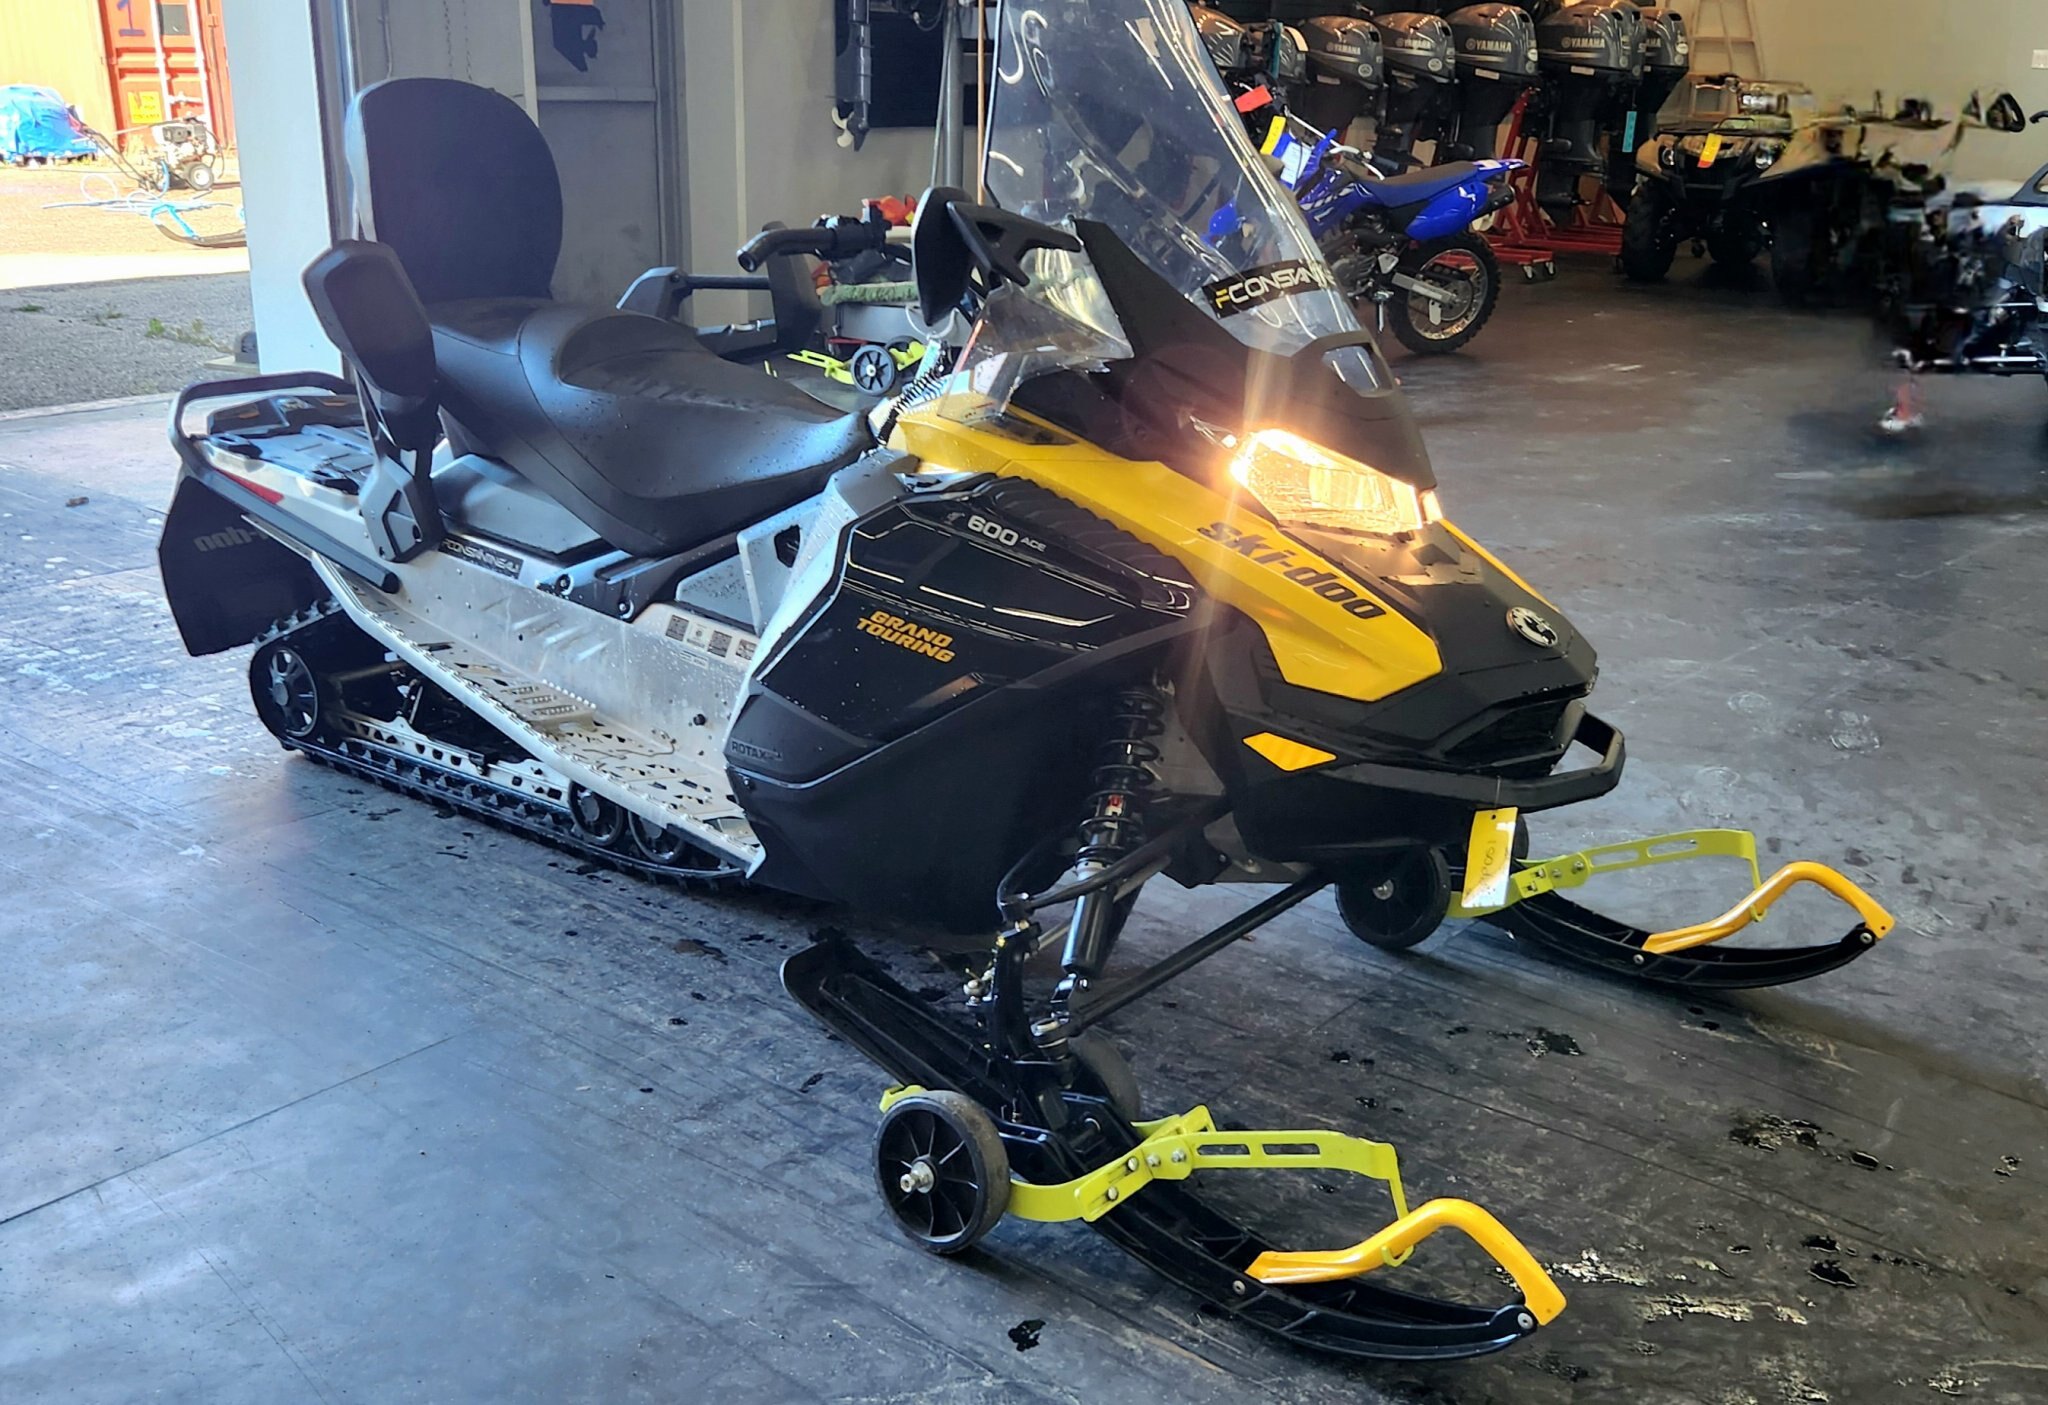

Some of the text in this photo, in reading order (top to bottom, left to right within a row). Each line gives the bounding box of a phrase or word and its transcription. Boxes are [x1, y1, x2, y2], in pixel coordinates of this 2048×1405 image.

[1334, 44, 1361, 55] YAMAHA
[1404, 39, 1432, 50] YAMAHA
[1475, 39, 1512, 53] YAMAHA
[1571, 37, 1606, 49] YAMAHA
[967, 514, 1047, 553] 600 ACE
[1197, 521, 1387, 619] ski-doo
[870, 610, 953, 648] GRAND
[856, 617, 956, 663] TOURING
[731, 741, 766, 760] ROTAX
